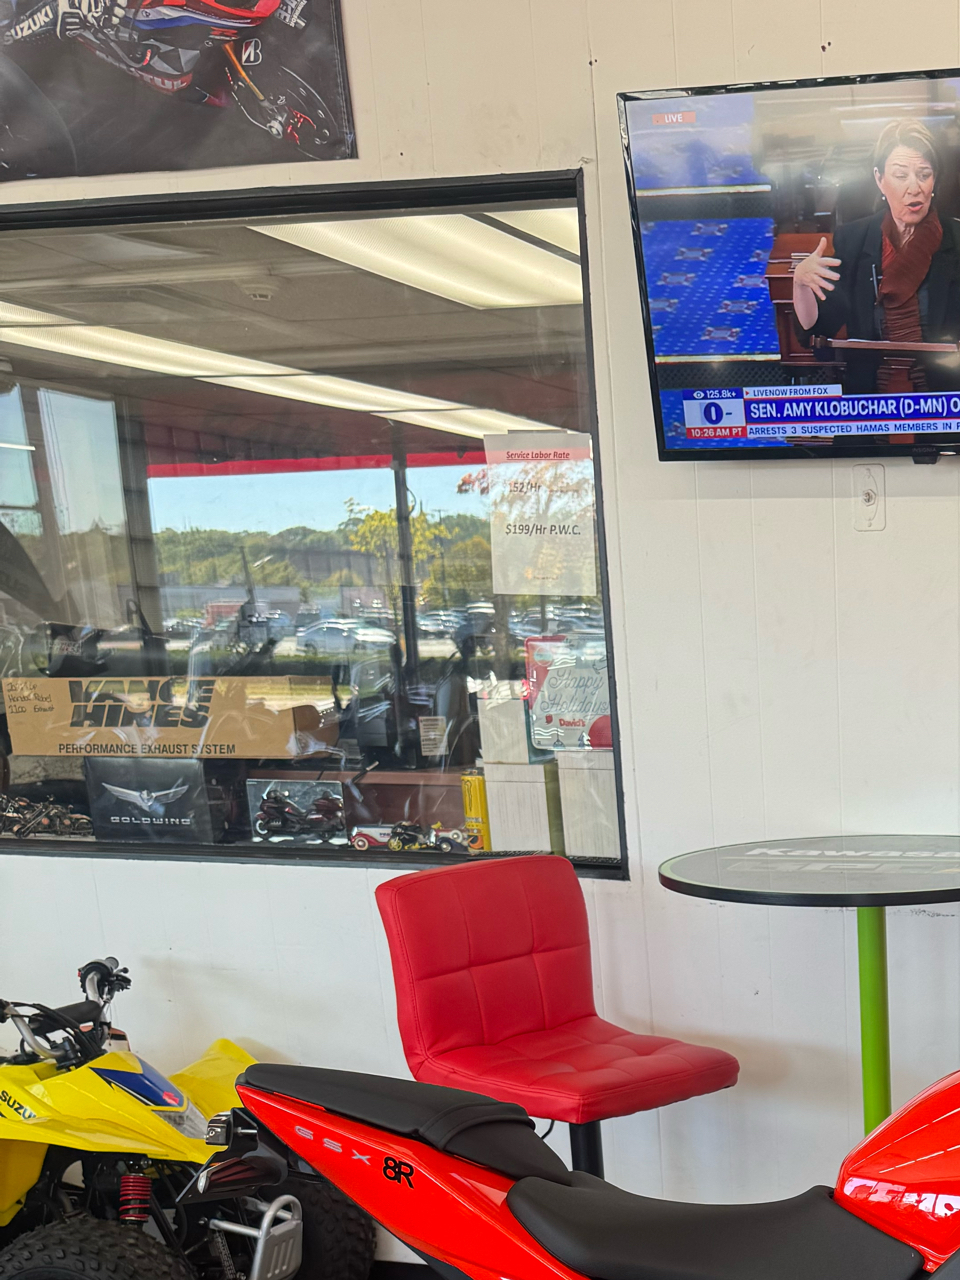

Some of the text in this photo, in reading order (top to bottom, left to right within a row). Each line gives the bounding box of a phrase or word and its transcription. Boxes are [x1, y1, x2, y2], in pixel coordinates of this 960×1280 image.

[2, 6, 54, 46] SUZUKI
[665, 113, 683, 123] LIVE
[753, 387, 828, 397] LIVENOW FROM FOX
[750, 401, 781, 418] SEN.
[783, 401, 813, 417] AMY
[815, 398, 897, 417] KLOBUCHAR
[899, 396, 947, 417] (D-MN)
[691, 427, 743, 437] 10:26 AM PT
[749, 426, 787, 436] ARRESTS
[791, 426, 797, 434] 3
[801, 425, 852, 435] SUSPECTED
[856, 424, 890, 433] HAMAS
[894, 422, 938, 432] MEMBERS
[942, 422, 952, 431] IN
[506, 451, 571, 460] Service Labor Rate
[506, 481, 542, 494] 152/Hr
[505, 523, 581, 537] $199/Hr P.W.C.
[549, 669, 605, 695] Happy
[58, 743, 236, 755] PERFORMANCE EXHAUST SYSTEM
[110, 815, 191, 826] GOLDWING
